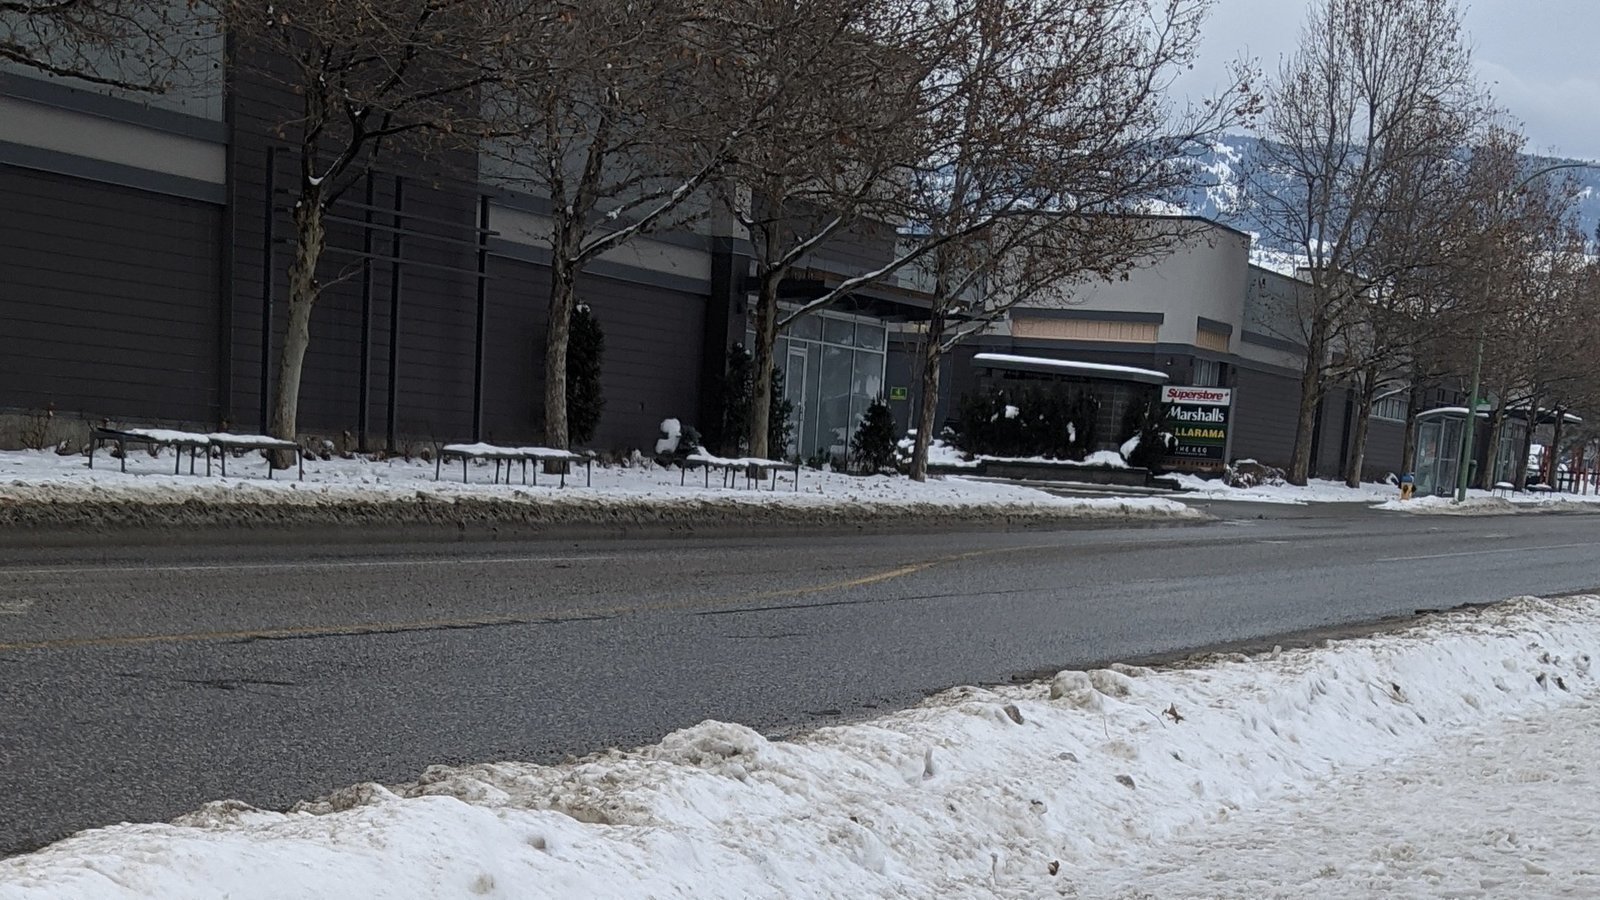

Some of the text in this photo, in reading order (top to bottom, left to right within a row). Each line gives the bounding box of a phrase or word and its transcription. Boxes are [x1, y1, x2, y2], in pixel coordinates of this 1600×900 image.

[1167, 388, 1223, 400] Superstore
[1171, 406, 1224, 422] Marshalls
[1175, 428, 1225, 438] LLARAMA
